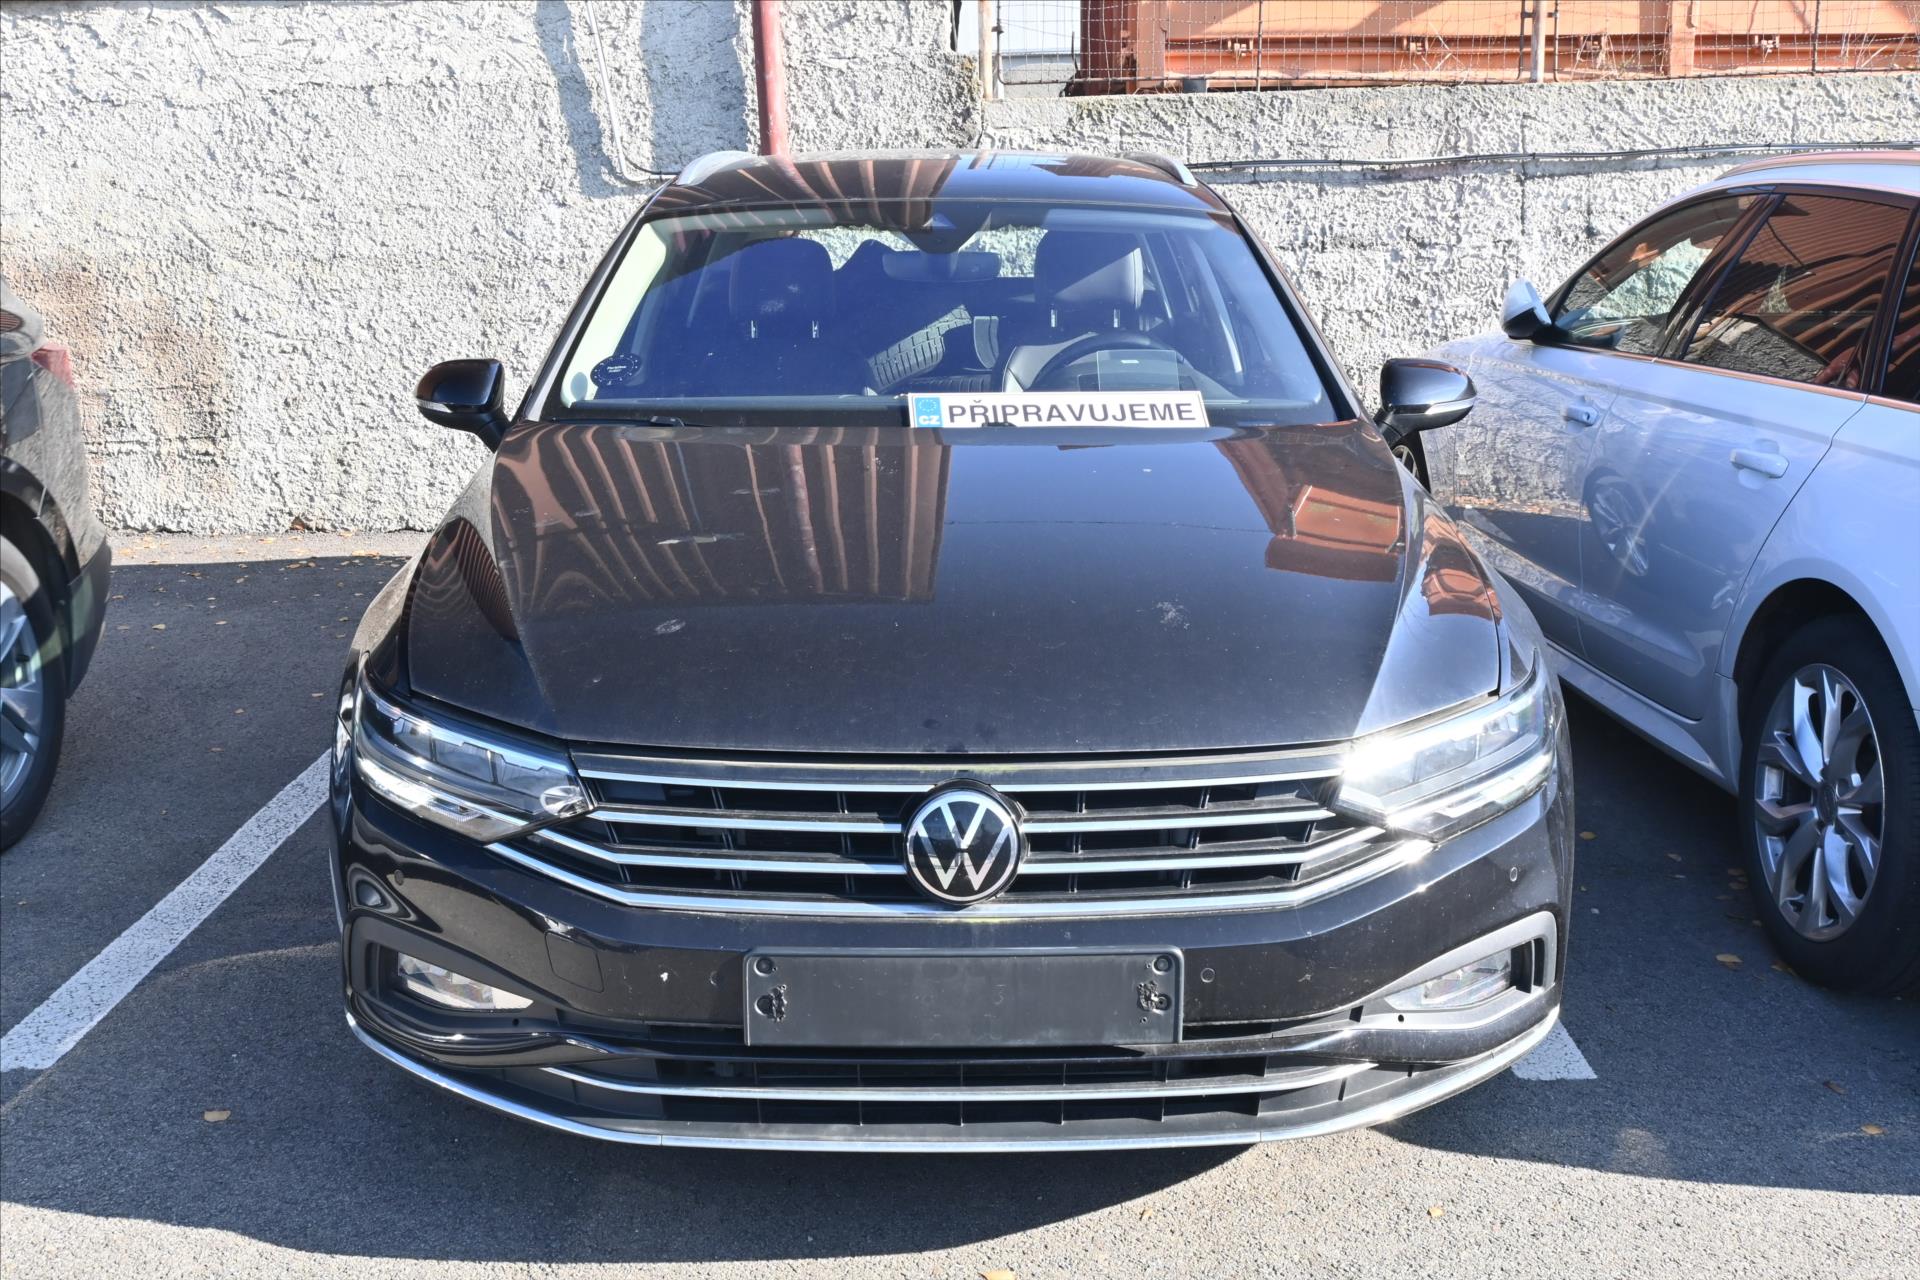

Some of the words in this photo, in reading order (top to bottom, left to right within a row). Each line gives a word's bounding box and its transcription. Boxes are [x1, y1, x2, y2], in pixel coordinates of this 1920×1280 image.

[918, 415, 941, 425] CZ
[948, 399, 1196, 424] PŘIPRAVUJEME
[911, 796, 1013, 894] VW
